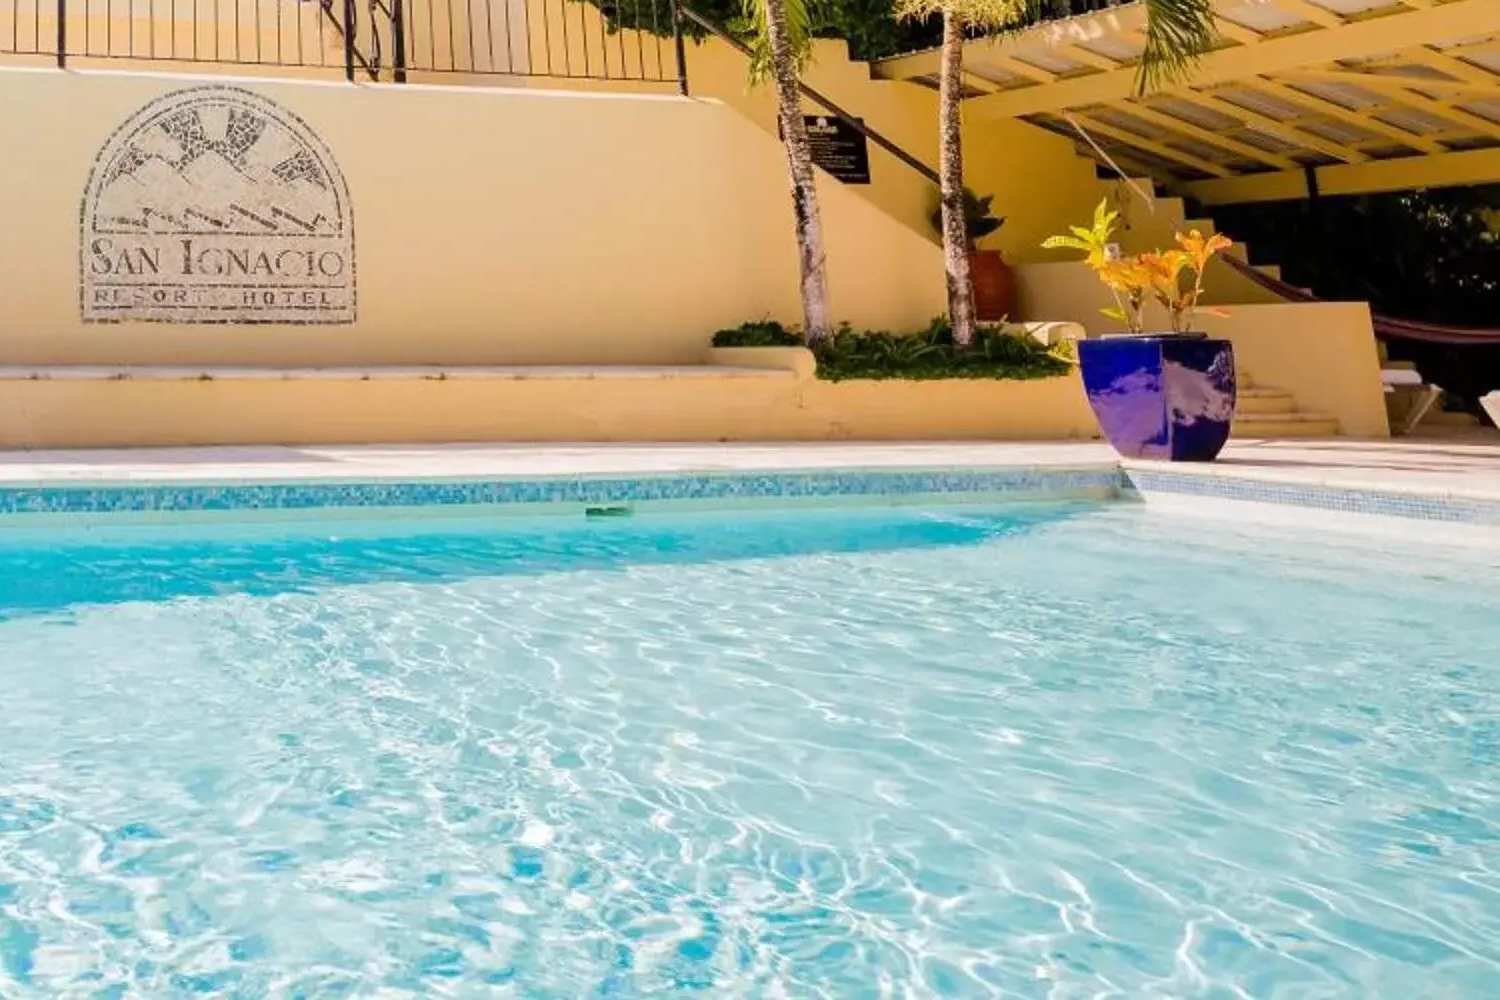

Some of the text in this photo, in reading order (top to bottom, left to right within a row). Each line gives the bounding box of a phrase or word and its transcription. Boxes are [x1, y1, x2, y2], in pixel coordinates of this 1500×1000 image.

[91, 237, 345, 278] SAN IGNACIO
[243, 291, 331, 304] HOTEL
